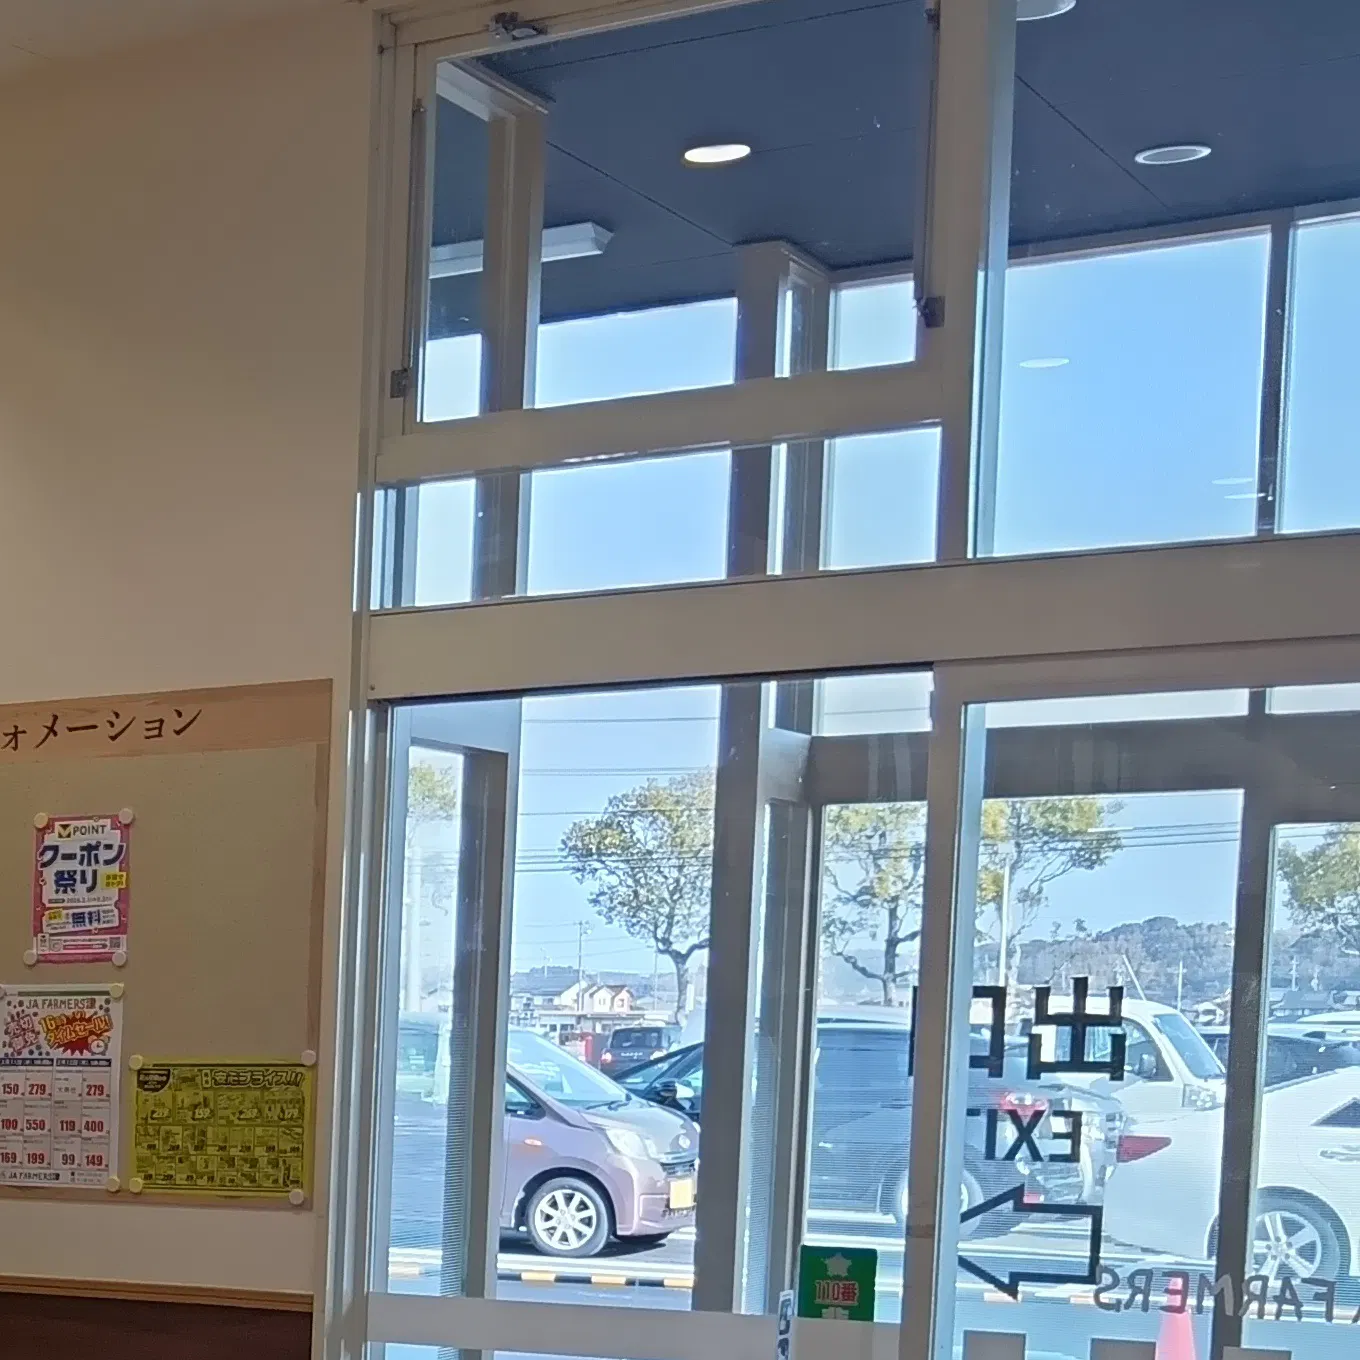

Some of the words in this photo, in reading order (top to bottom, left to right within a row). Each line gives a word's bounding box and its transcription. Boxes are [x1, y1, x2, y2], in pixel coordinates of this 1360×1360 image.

[39, 841, 124, 868] クーポン
[54, 869, 98, 894] 祭り
[26, 999, 39, 1009] JA
